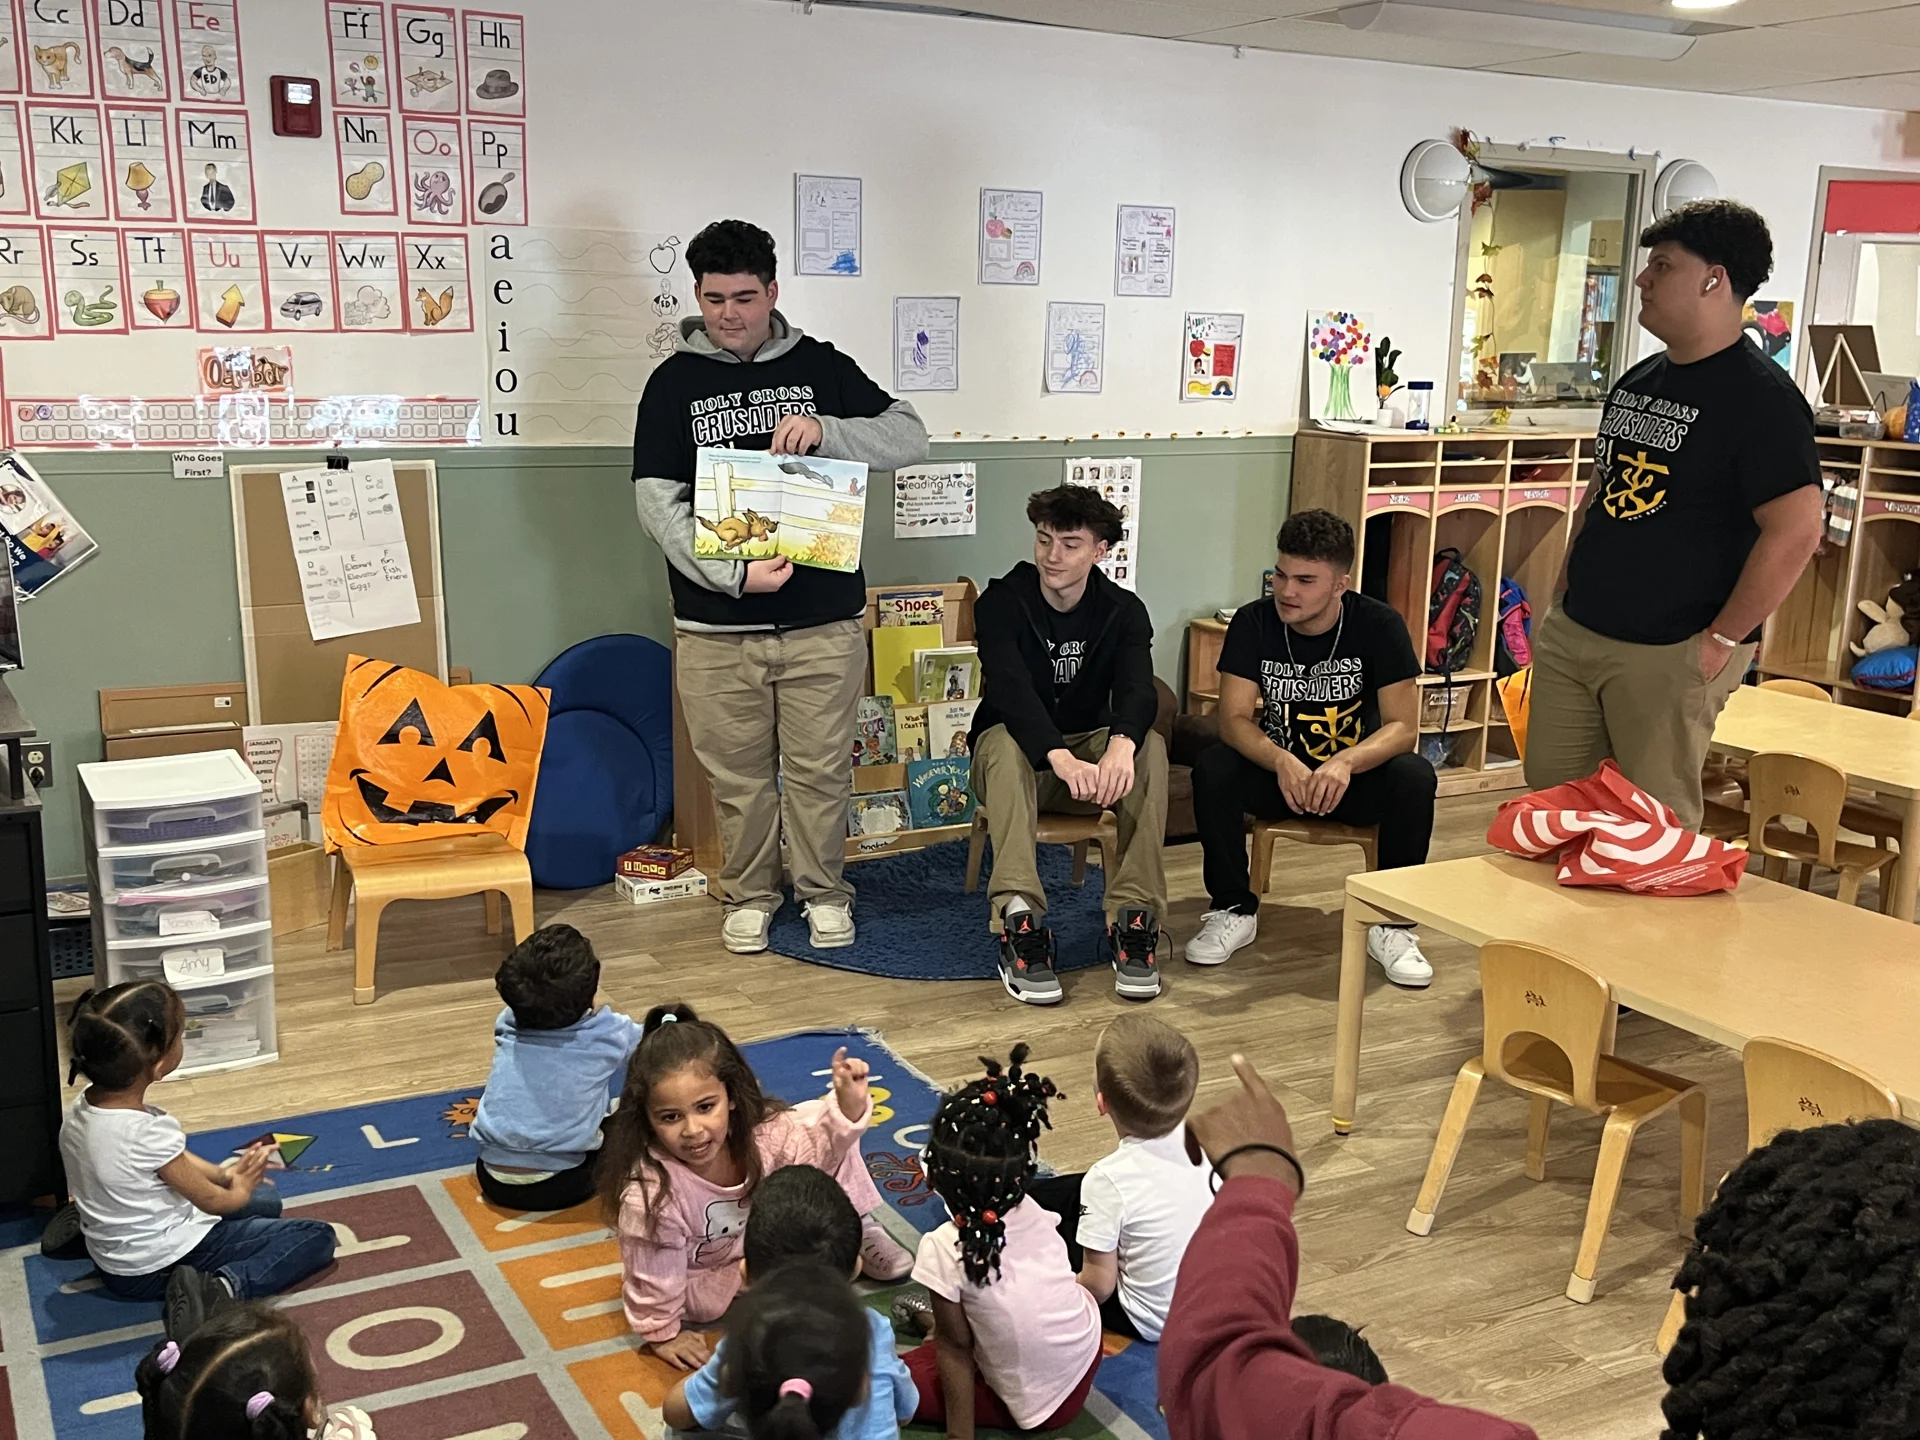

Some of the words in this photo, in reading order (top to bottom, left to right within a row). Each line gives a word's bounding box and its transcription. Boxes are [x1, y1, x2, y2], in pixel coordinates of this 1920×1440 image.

[34, 0, 69, 24] Cc
[108, 0, 144, 27] Dd
[188, 2, 220, 31] Ee
[343, 11, 370, 39] Ff
[406, 18, 443, 58] Gg
[480, 20, 510, 48] Hh
[50, 115, 84, 145] Kk
[188, 120, 237, 150] Mm
[344, 117, 378, 144] Nn
[413, 129, 451, 157] Oo
[482, 131, 508, 168] Pp
[0, 237, 24, 265] Rr
[70, 238, 99, 267] Ss
[134, 237, 166, 264] Tt
[208, 241, 241, 268] Uu
[278, 243, 313, 269] Vv
[338, 243, 386, 269] Ww
[414, 244, 447, 270] Xx
[490, 234, 514, 260] a
[493, 278, 514, 305] e
[497, 321, 511, 353] i
[495, 368, 518, 393] o
[690, 392, 742, 416] HOLY
[748, 385, 814, 404] CROSS
[1612, 389, 1652, 410] HOLY
[1649, 398, 1699, 423] CROSS
[494, 411, 520, 436] u
[174, 454, 195, 462] Who
[198, 454, 222, 462] Goes
[184, 469, 212, 477] First?
[365, 474, 372, 482] C
[351, 554, 356, 562] E
[350, 582, 371, 592] Eggs
[895, 599, 939, 612] Shoes
[1261, 659, 1306, 678] HOLY
[1310, 657, 1363, 677] CROSS
[247, 749, 280, 757] FEBRUARY
[912, 766, 949, 788] WHOEVER
[947, 764, 964, 776] YOU
[360, 1124, 421, 1149] L
